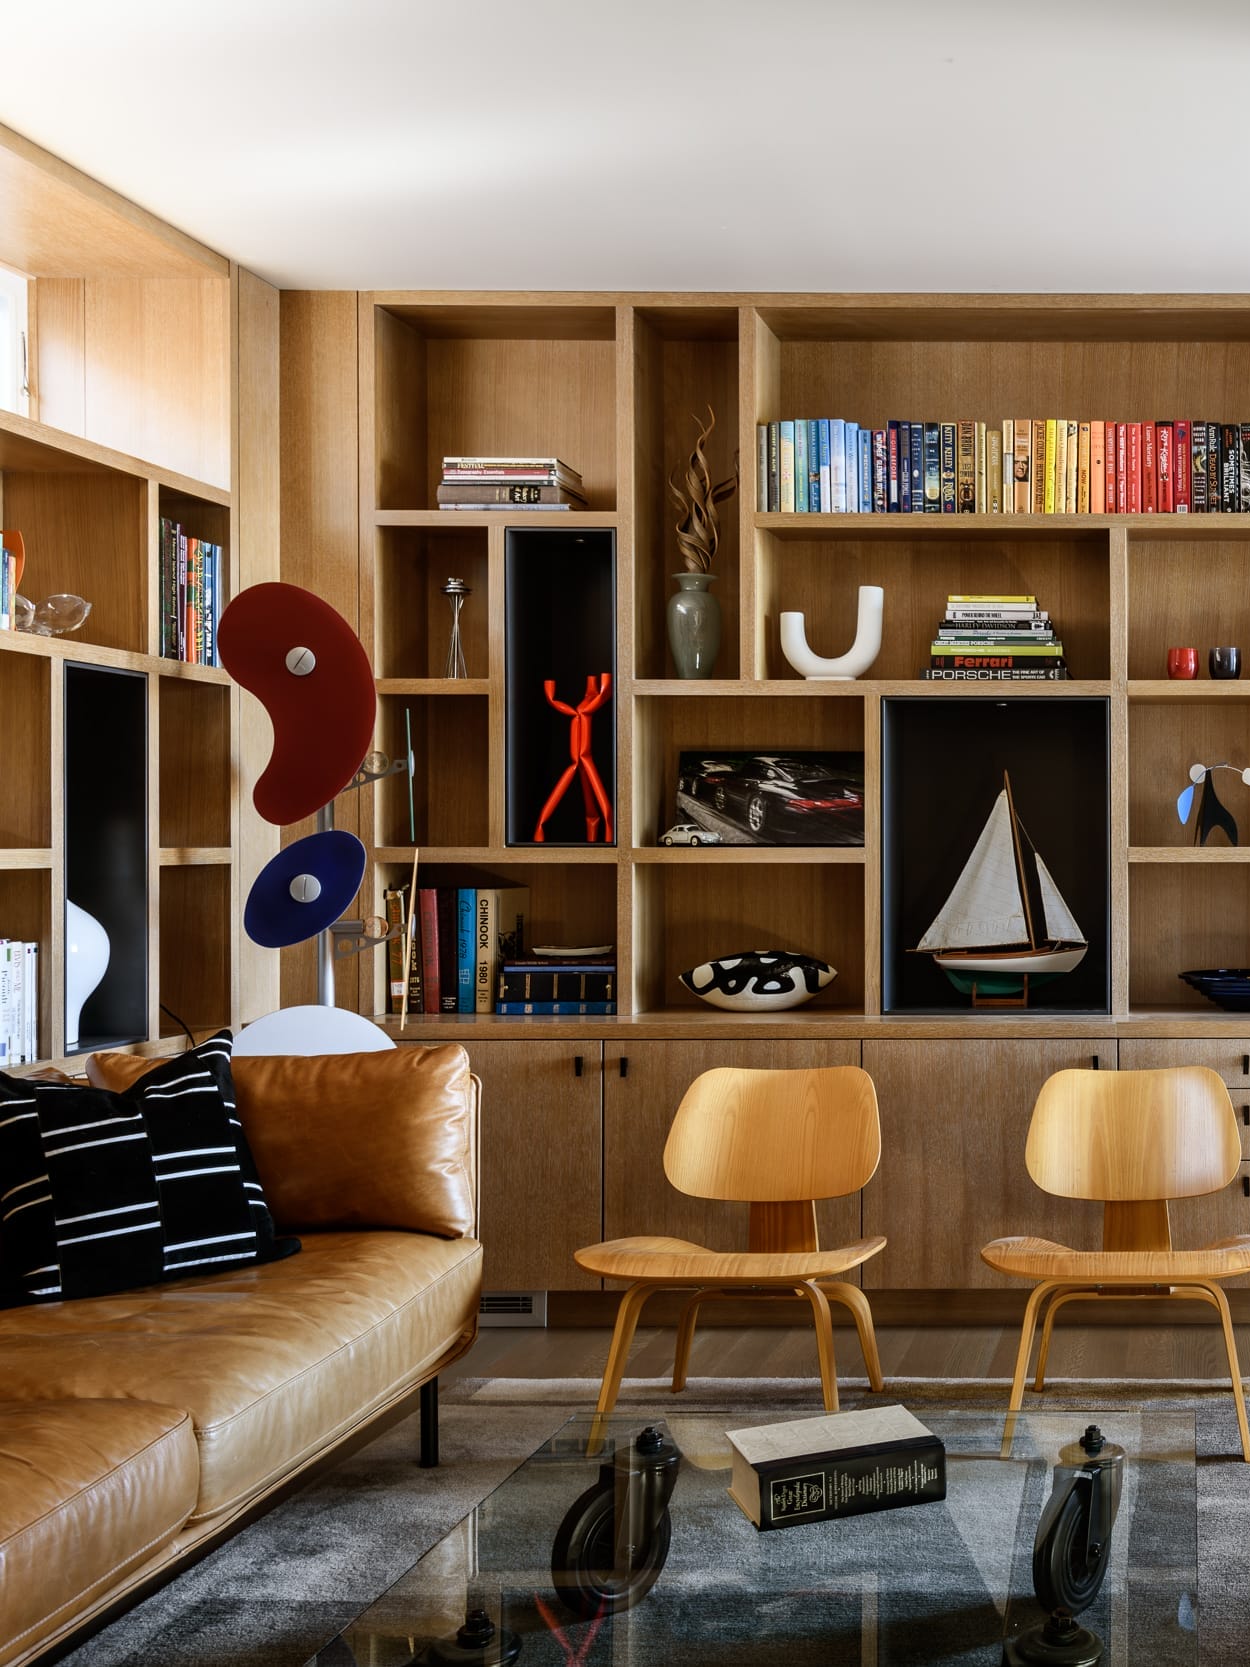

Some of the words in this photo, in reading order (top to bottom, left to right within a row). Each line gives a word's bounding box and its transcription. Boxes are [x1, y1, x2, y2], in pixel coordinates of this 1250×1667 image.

[944, 426, 952, 445] KITTY
[960, 422, 972, 434] DAN
[1035, 424, 1044, 440] JACKIE
[960, 435, 972, 457] BROWN
[944, 446, 952, 468] KELLEY
[954, 656, 1013, 668] Ferrari
[932, 670, 1011, 680] PORSCHE
[458, 900, 472, 934] Chinook
[479, 899, 489, 949] CHINOOK
[392, 952, 401, 965] 77
[459, 938, 467, 959] 1978
[478, 961, 488, 984] 1980
